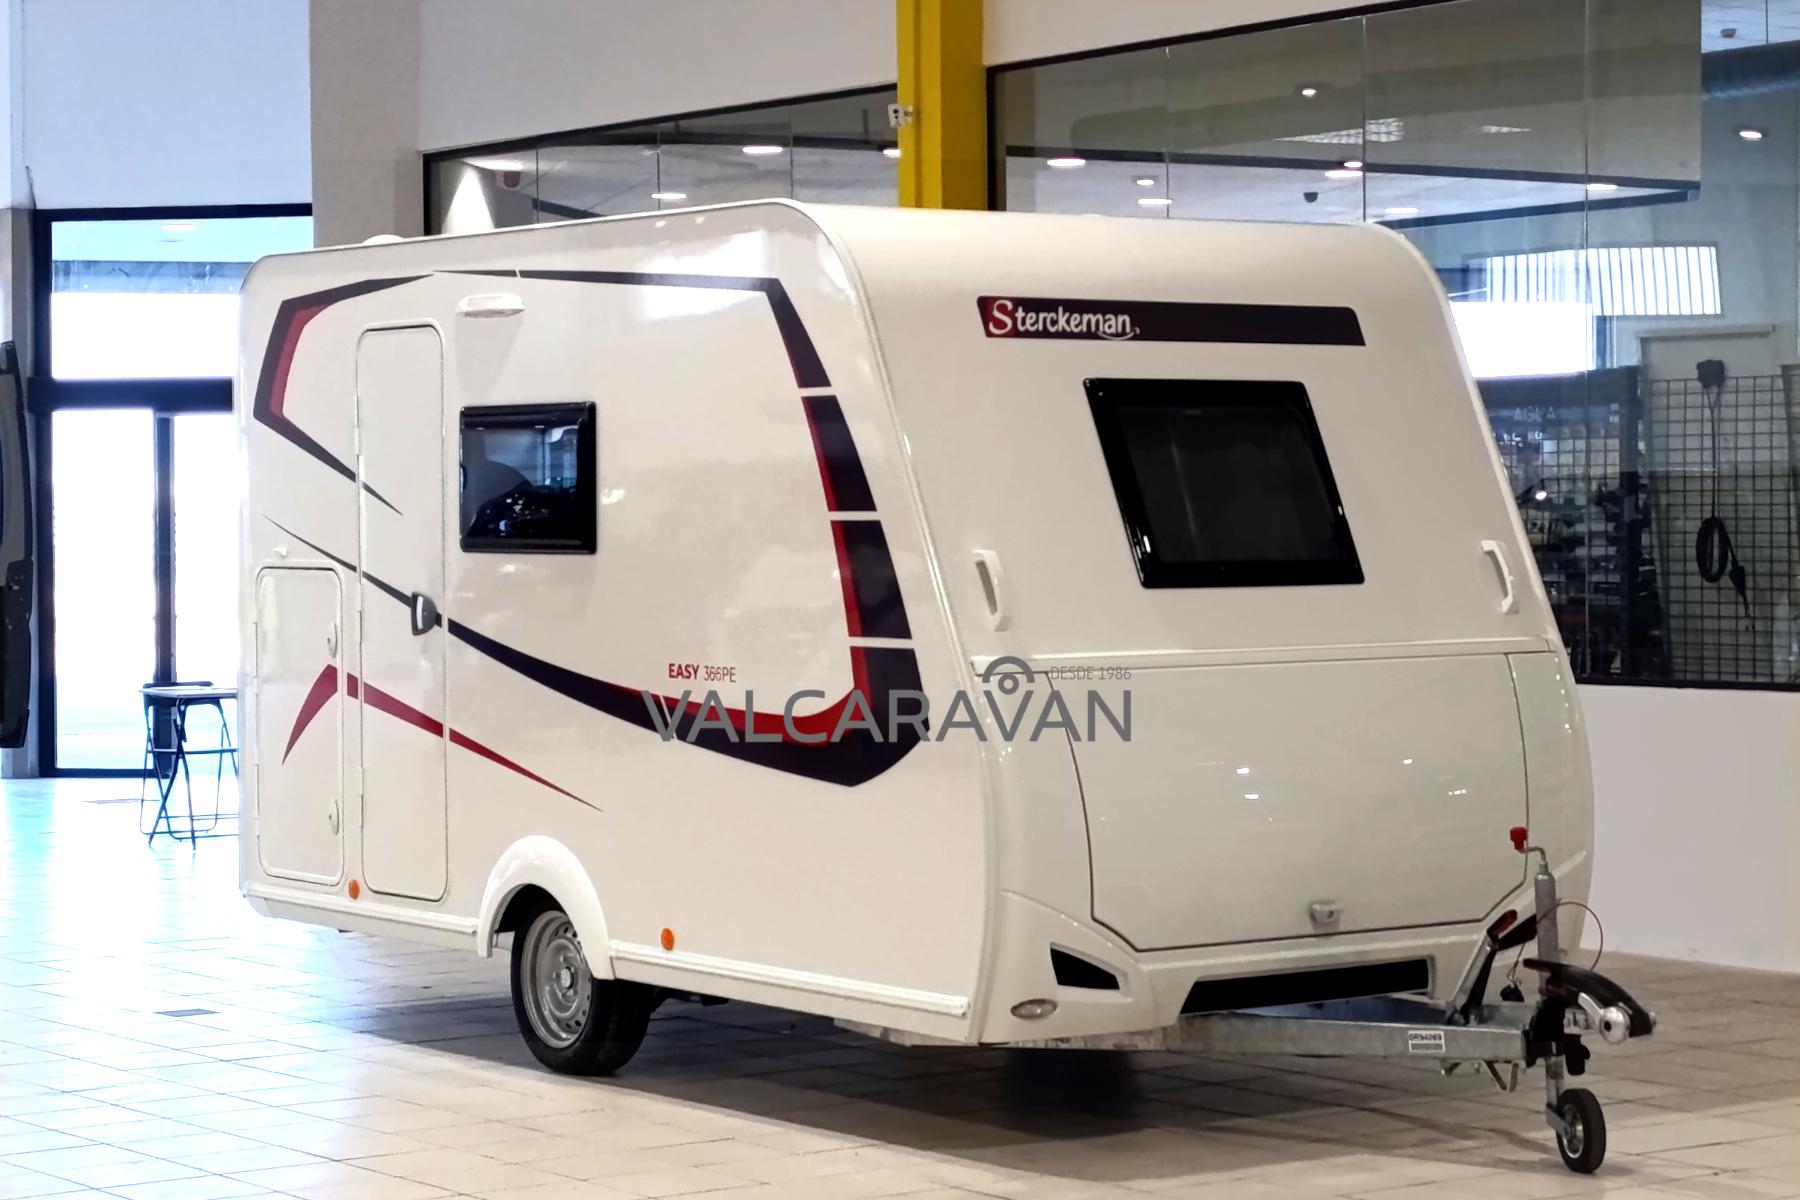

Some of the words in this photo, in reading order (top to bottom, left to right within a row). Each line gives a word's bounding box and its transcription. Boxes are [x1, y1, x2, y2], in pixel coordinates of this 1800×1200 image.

[989, 300, 1136, 340] Sterckeman
[669, 658, 700, 680] EASY
[703, 660, 736, 683] 366PE
